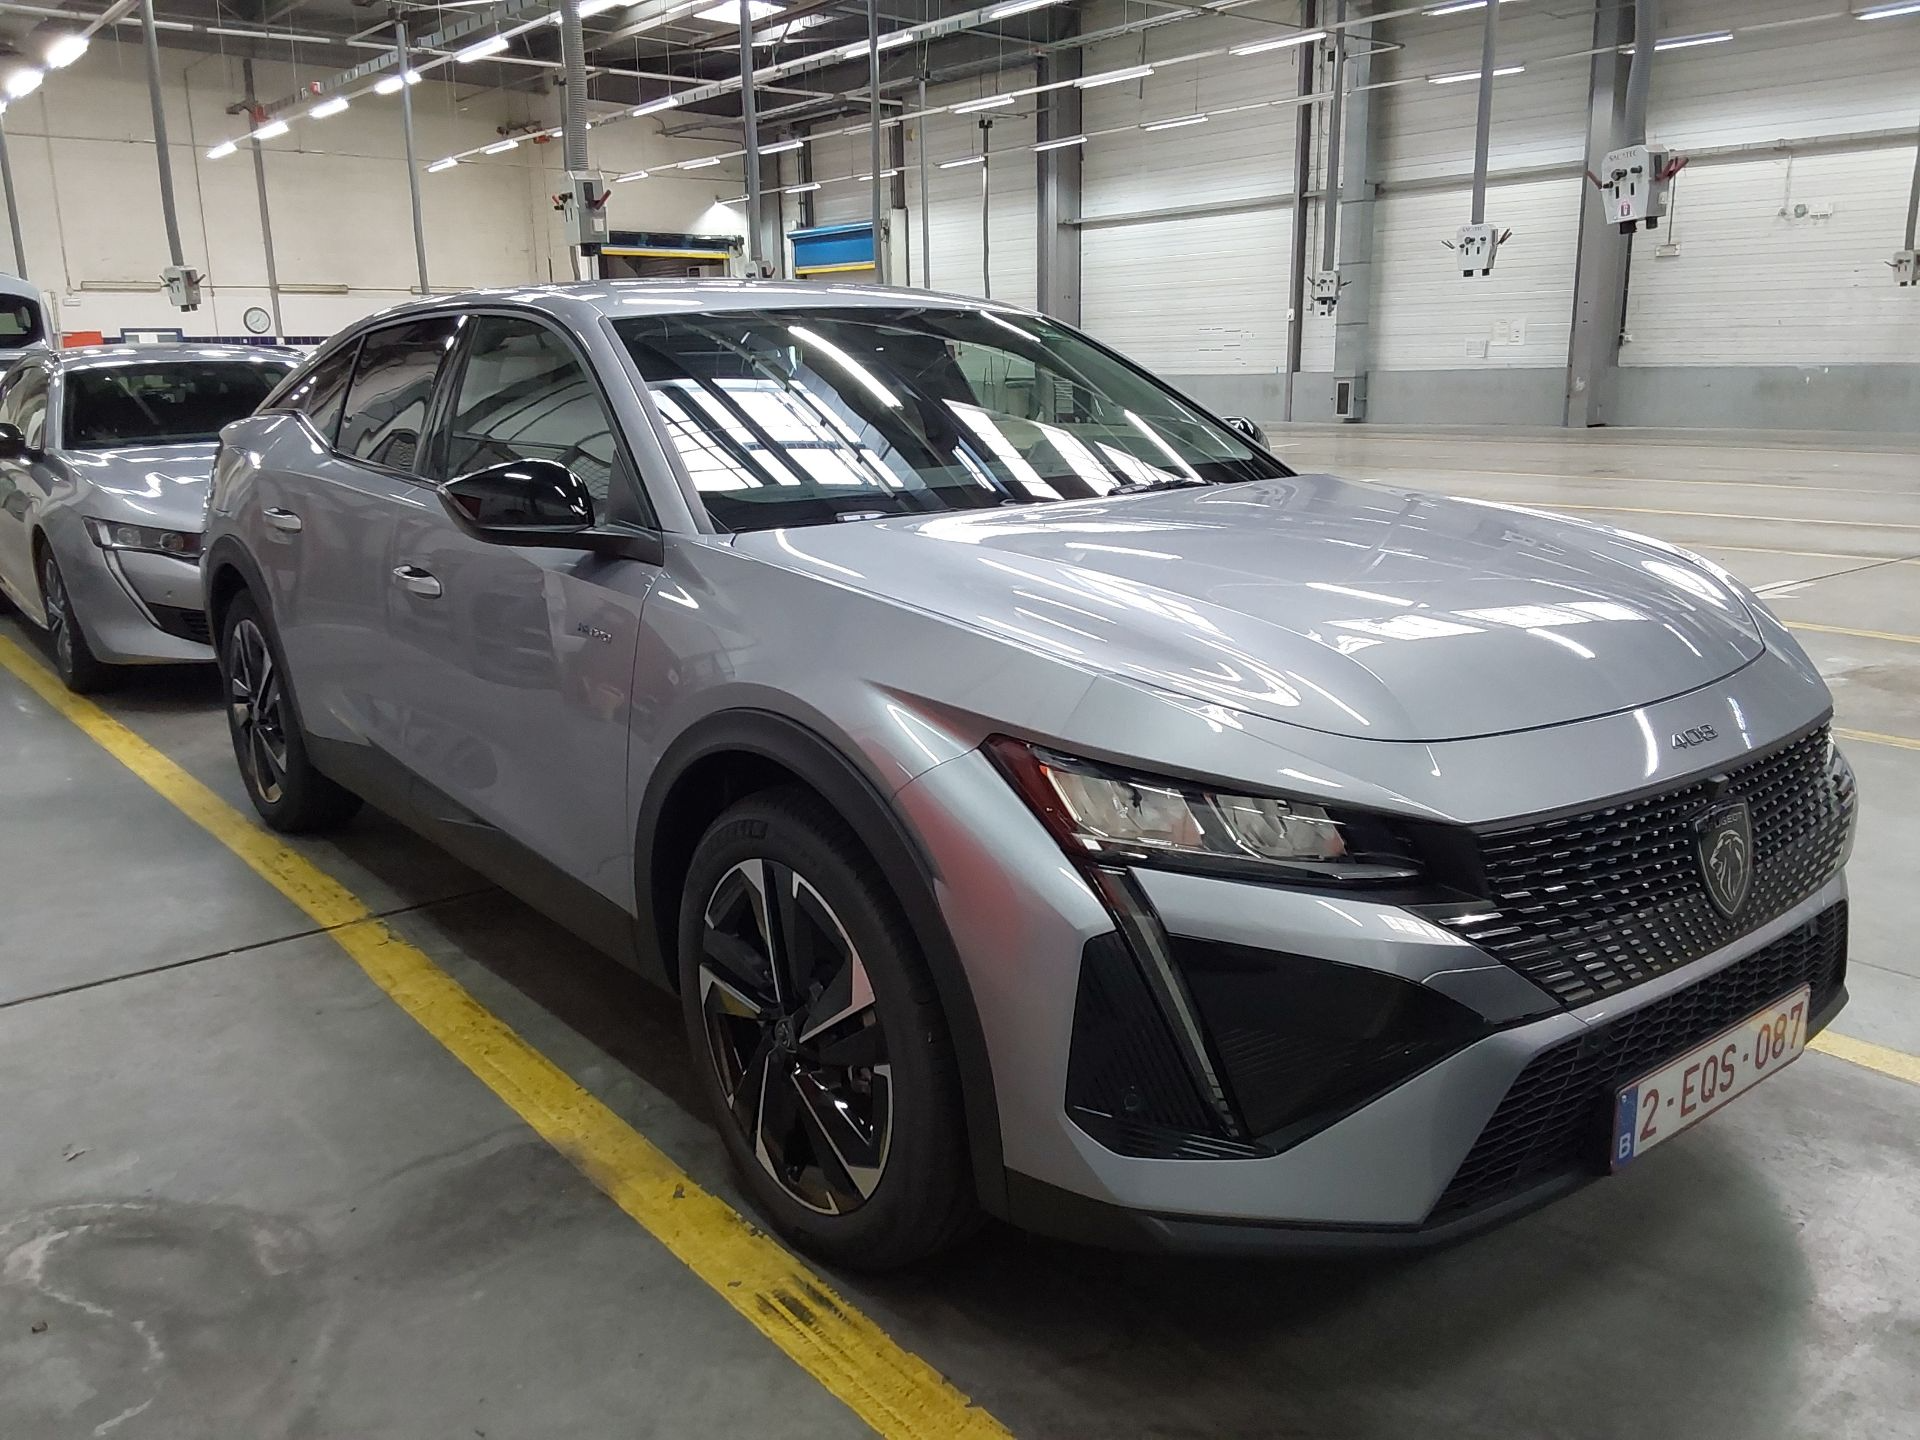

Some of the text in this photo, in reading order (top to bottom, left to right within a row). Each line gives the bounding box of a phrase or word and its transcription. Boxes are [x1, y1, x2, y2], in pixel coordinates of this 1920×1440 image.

[1671, 724, 1718, 750] 408
[1702, 811, 1743, 832] UGEOT
[1639, 1001, 1804, 1142] 2-EQS-087
[1618, 1135, 1631, 1159] B
